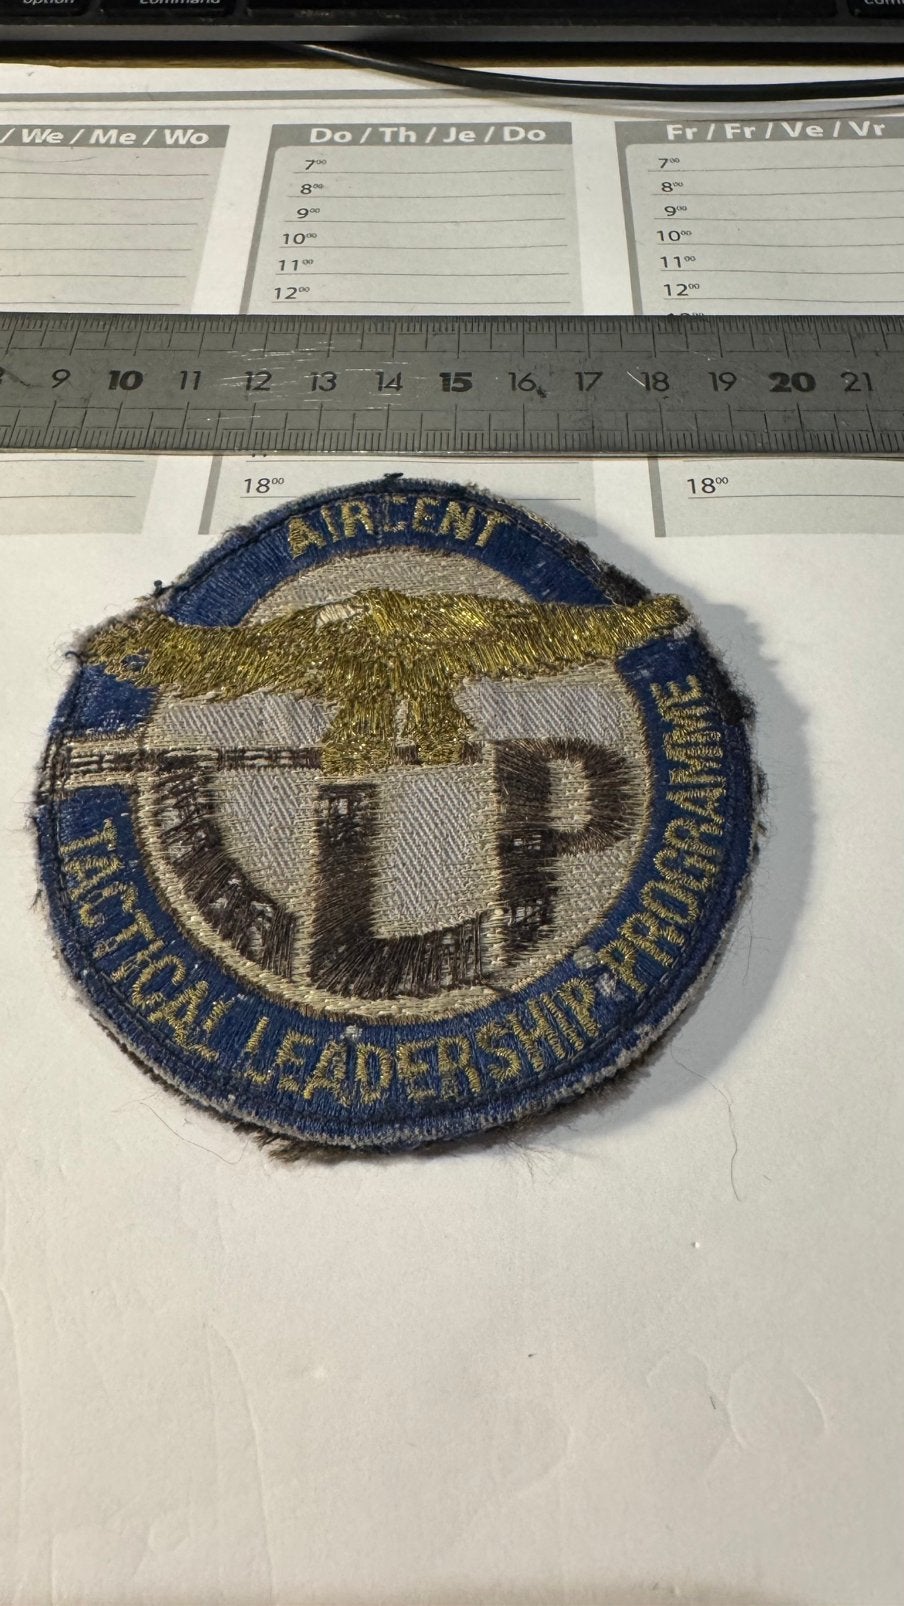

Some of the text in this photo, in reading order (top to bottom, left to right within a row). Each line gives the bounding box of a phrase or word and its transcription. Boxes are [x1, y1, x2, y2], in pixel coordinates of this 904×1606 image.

[21, 128, 65, 144] We
[89, 128, 137, 145] Me
[164, 128, 210, 145] Wo
[309, 127, 353, 143] Do
[379, 126, 417, 143] Th
[443, 126, 477, 143] Je
[503, 126, 546, 142] Do
[666, 124, 698, 140] Fr
[724, 123, 756, 139] Fr
[781, 121, 824, 138] Ve
[848, 120, 885, 137] Vr
[51, 368, 874, 393] 9 10 11 12 13 14 15 16 17 18 19 20 21
[59, 673, 728, 1107] TACTICAL LEADERSHIP PROGRAMME
